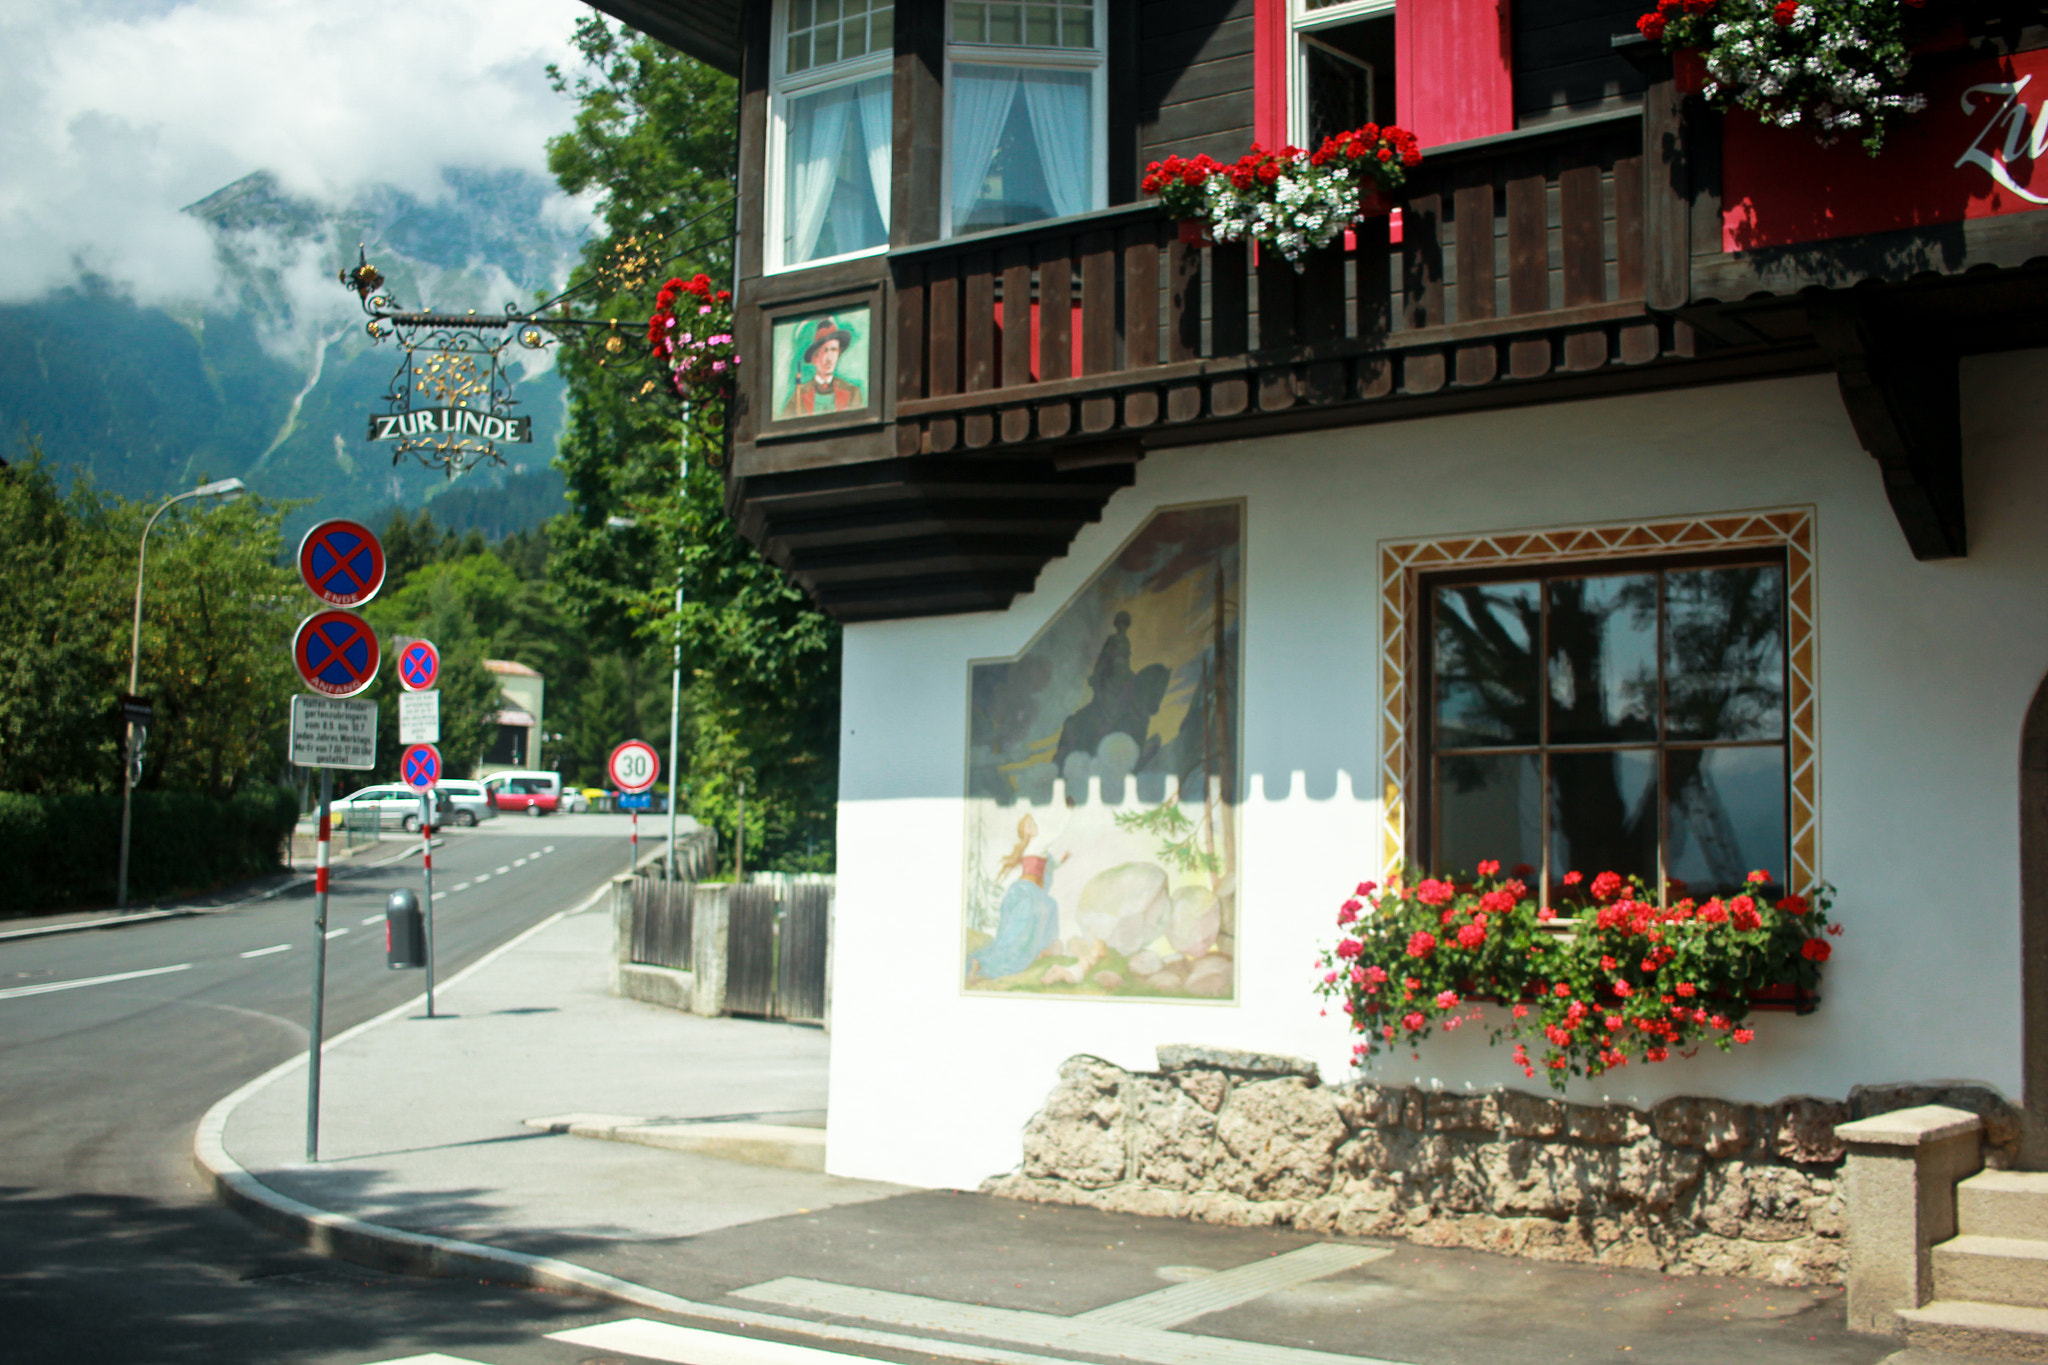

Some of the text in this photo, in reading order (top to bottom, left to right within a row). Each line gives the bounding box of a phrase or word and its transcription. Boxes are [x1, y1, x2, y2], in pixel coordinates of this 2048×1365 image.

[376, 409, 521, 442] ZUR LINDE
[324, 590, 359, 604] ENDE
[310, 676, 362, 694] ANFANG
[622, 754, 646, 777] 30
